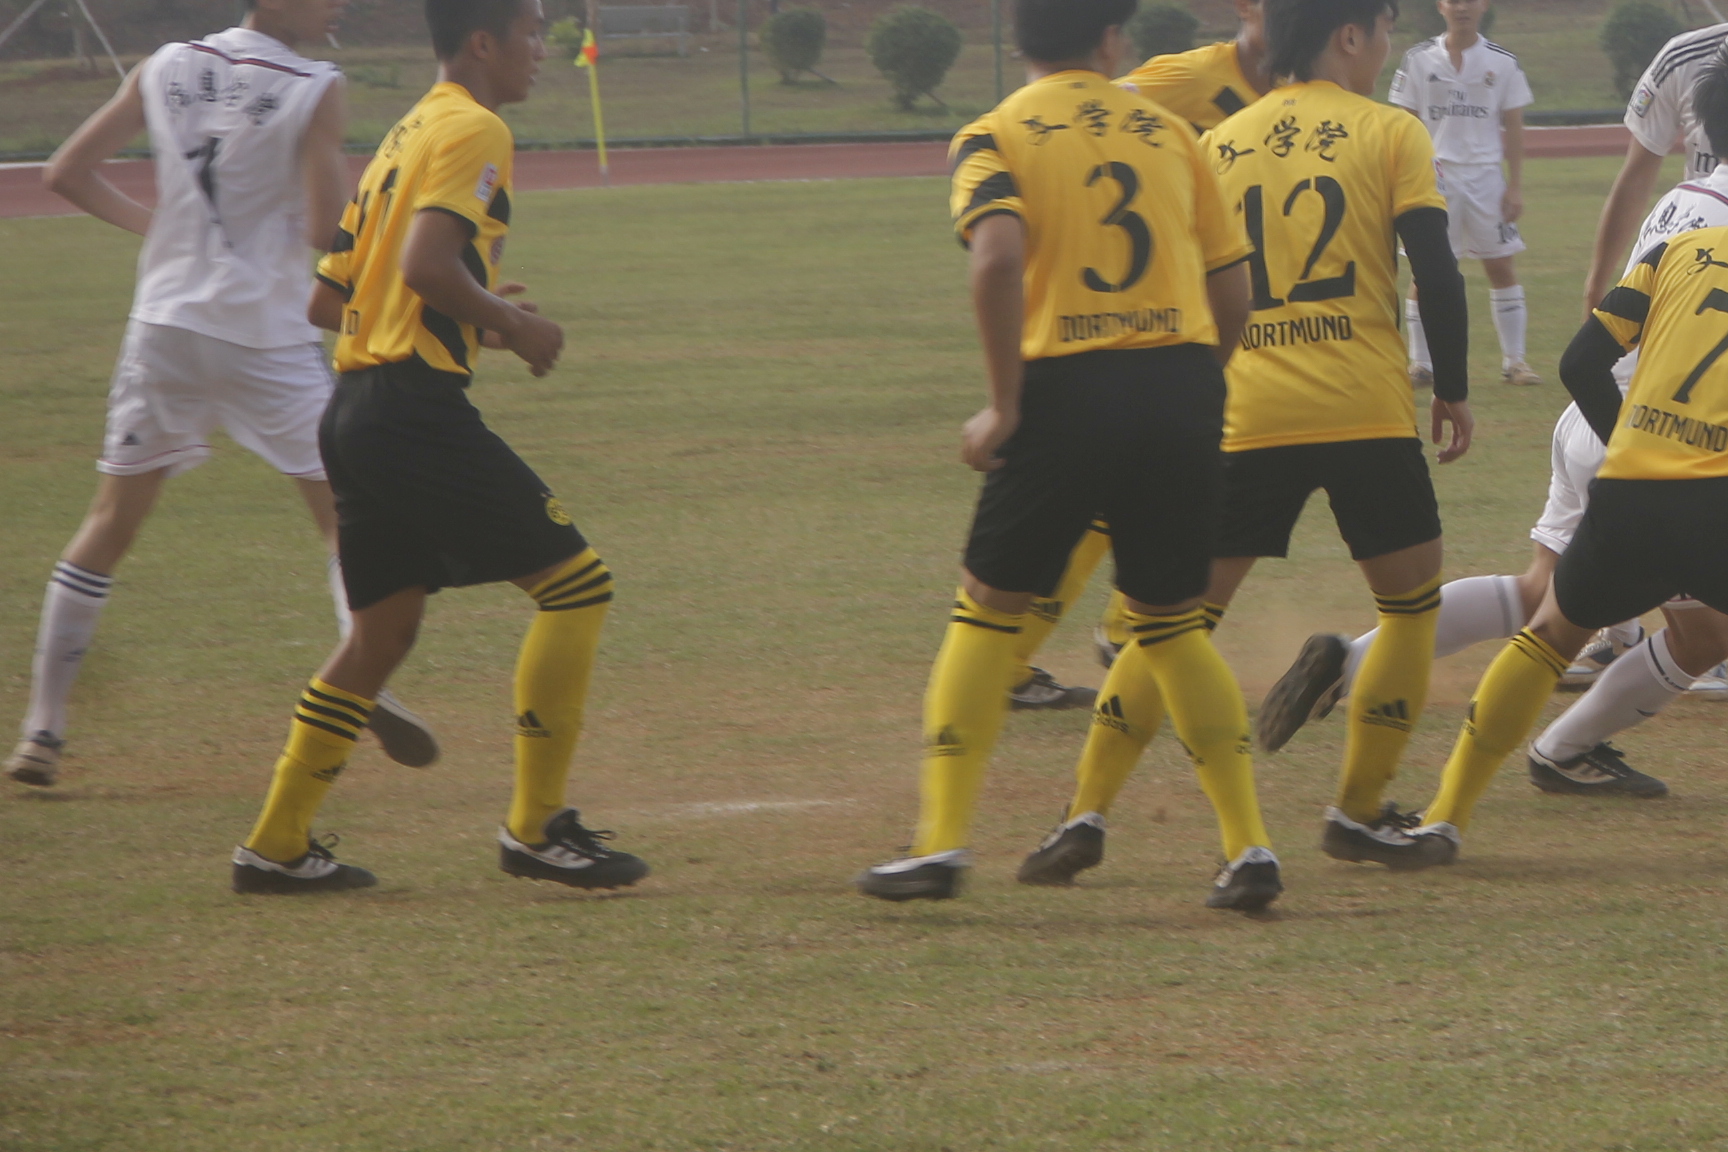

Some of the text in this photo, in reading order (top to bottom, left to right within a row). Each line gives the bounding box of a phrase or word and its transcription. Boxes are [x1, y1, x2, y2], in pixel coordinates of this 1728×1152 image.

[1081, 161, 1154, 293] 3
[1234, 175, 1356, 312] 12
[1058, 307, 1181, 342] DORTMUND
